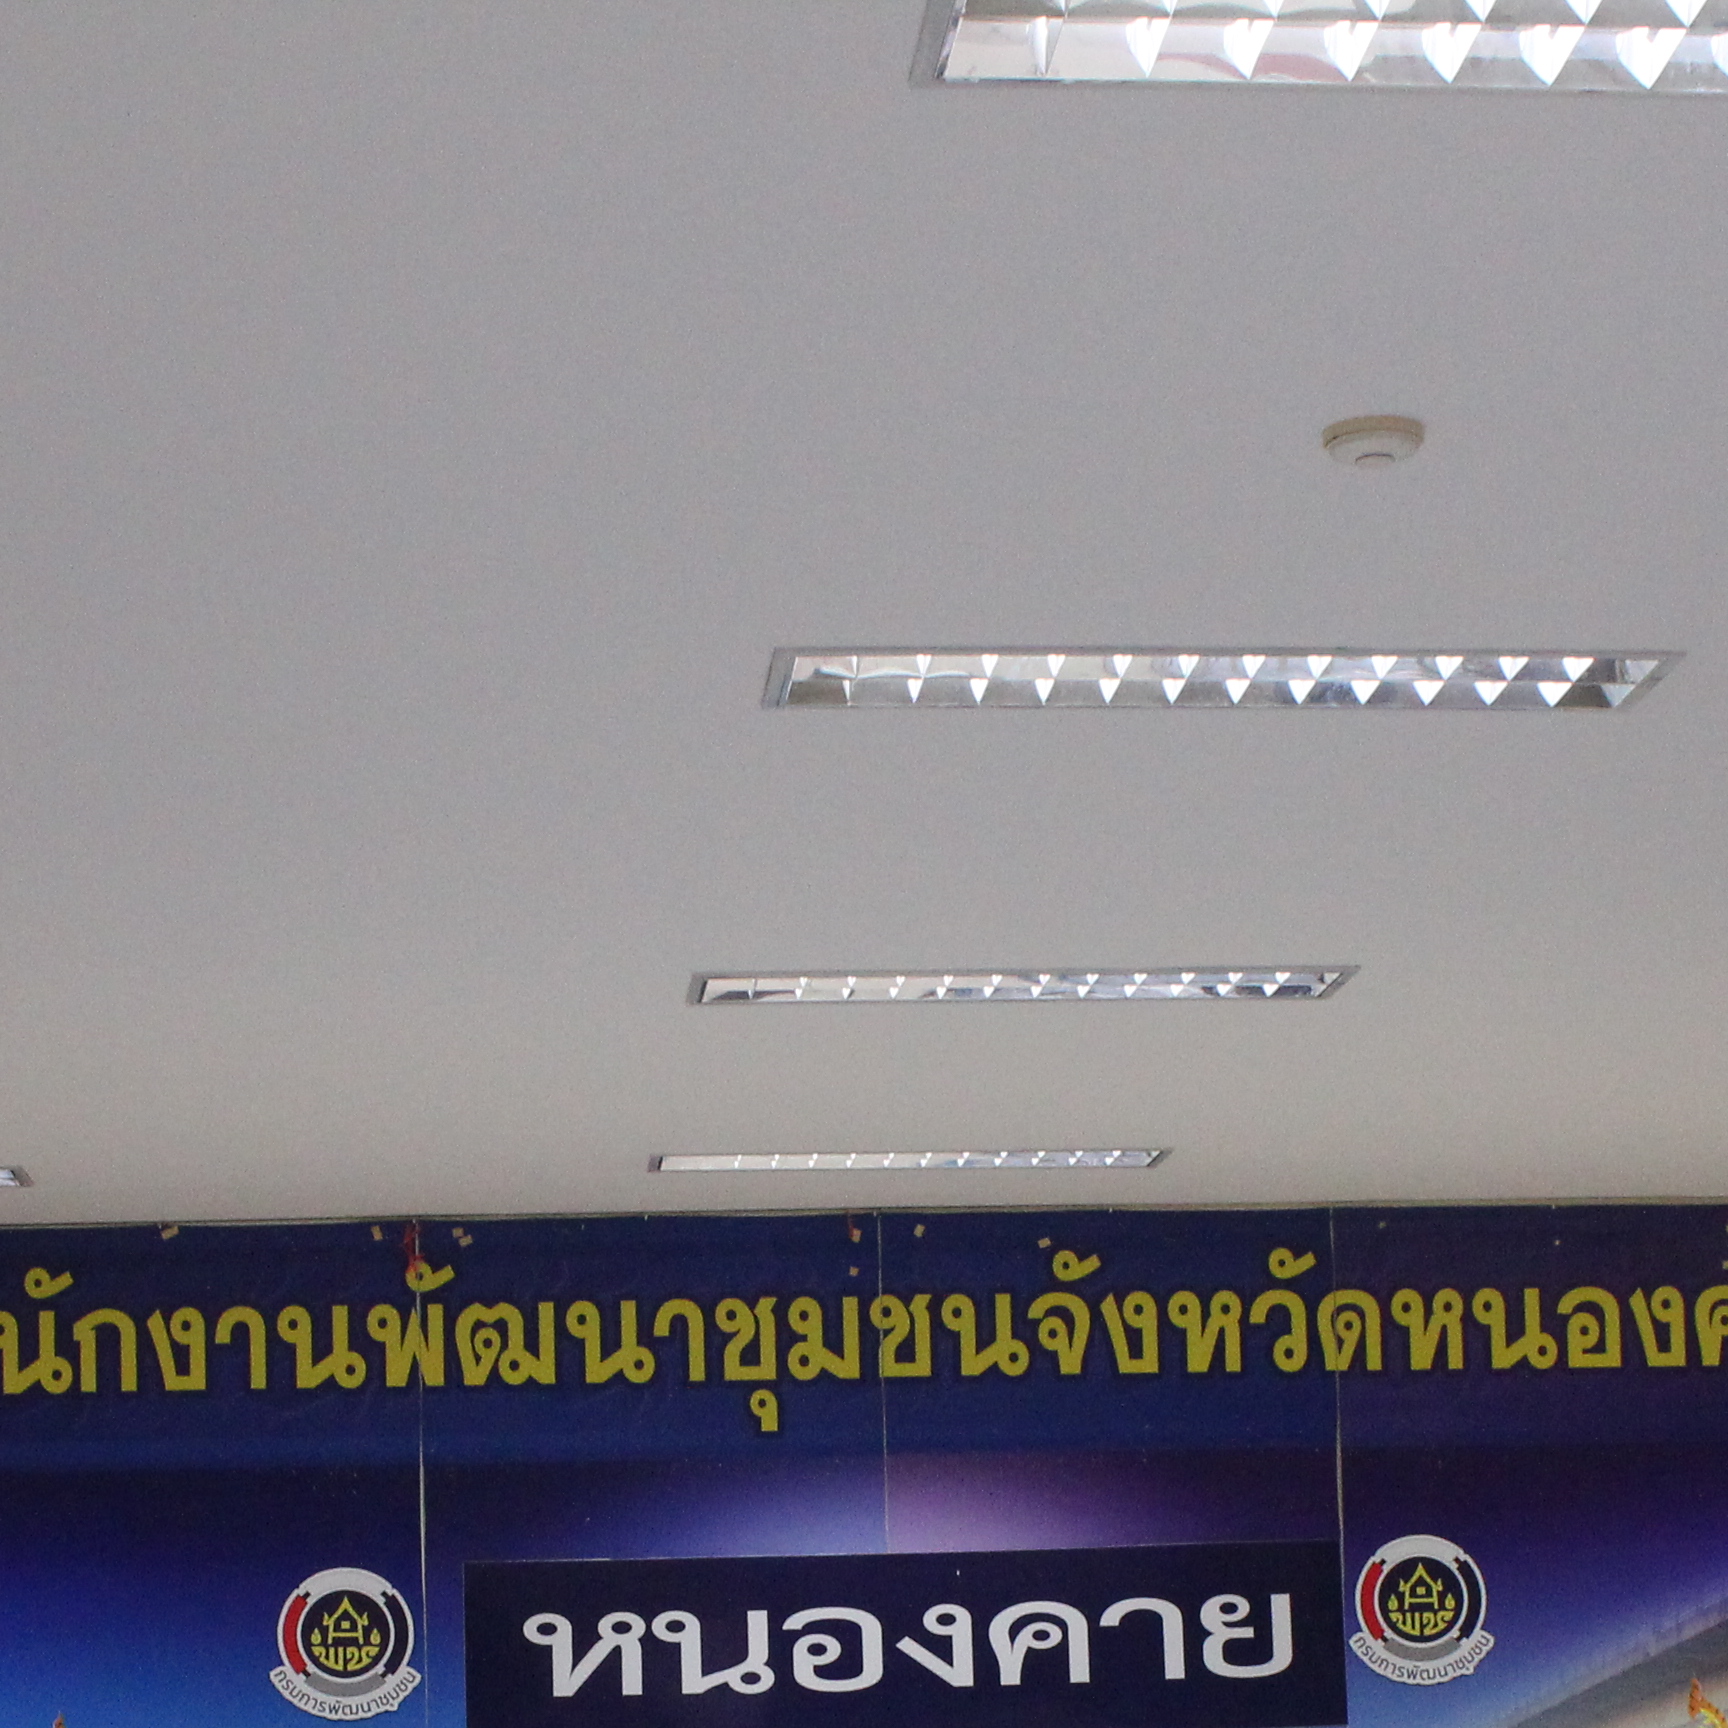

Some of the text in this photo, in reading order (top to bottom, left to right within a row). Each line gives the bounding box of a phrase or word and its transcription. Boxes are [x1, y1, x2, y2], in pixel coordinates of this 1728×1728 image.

[522, 1593, 1293, 1697] หนองคาย
[1353, 1632, 1492, 1682] กรมการพัฒนาชุมชน
[273, 1668, 417, 1717] กรมการพัฒนาชุมชน
